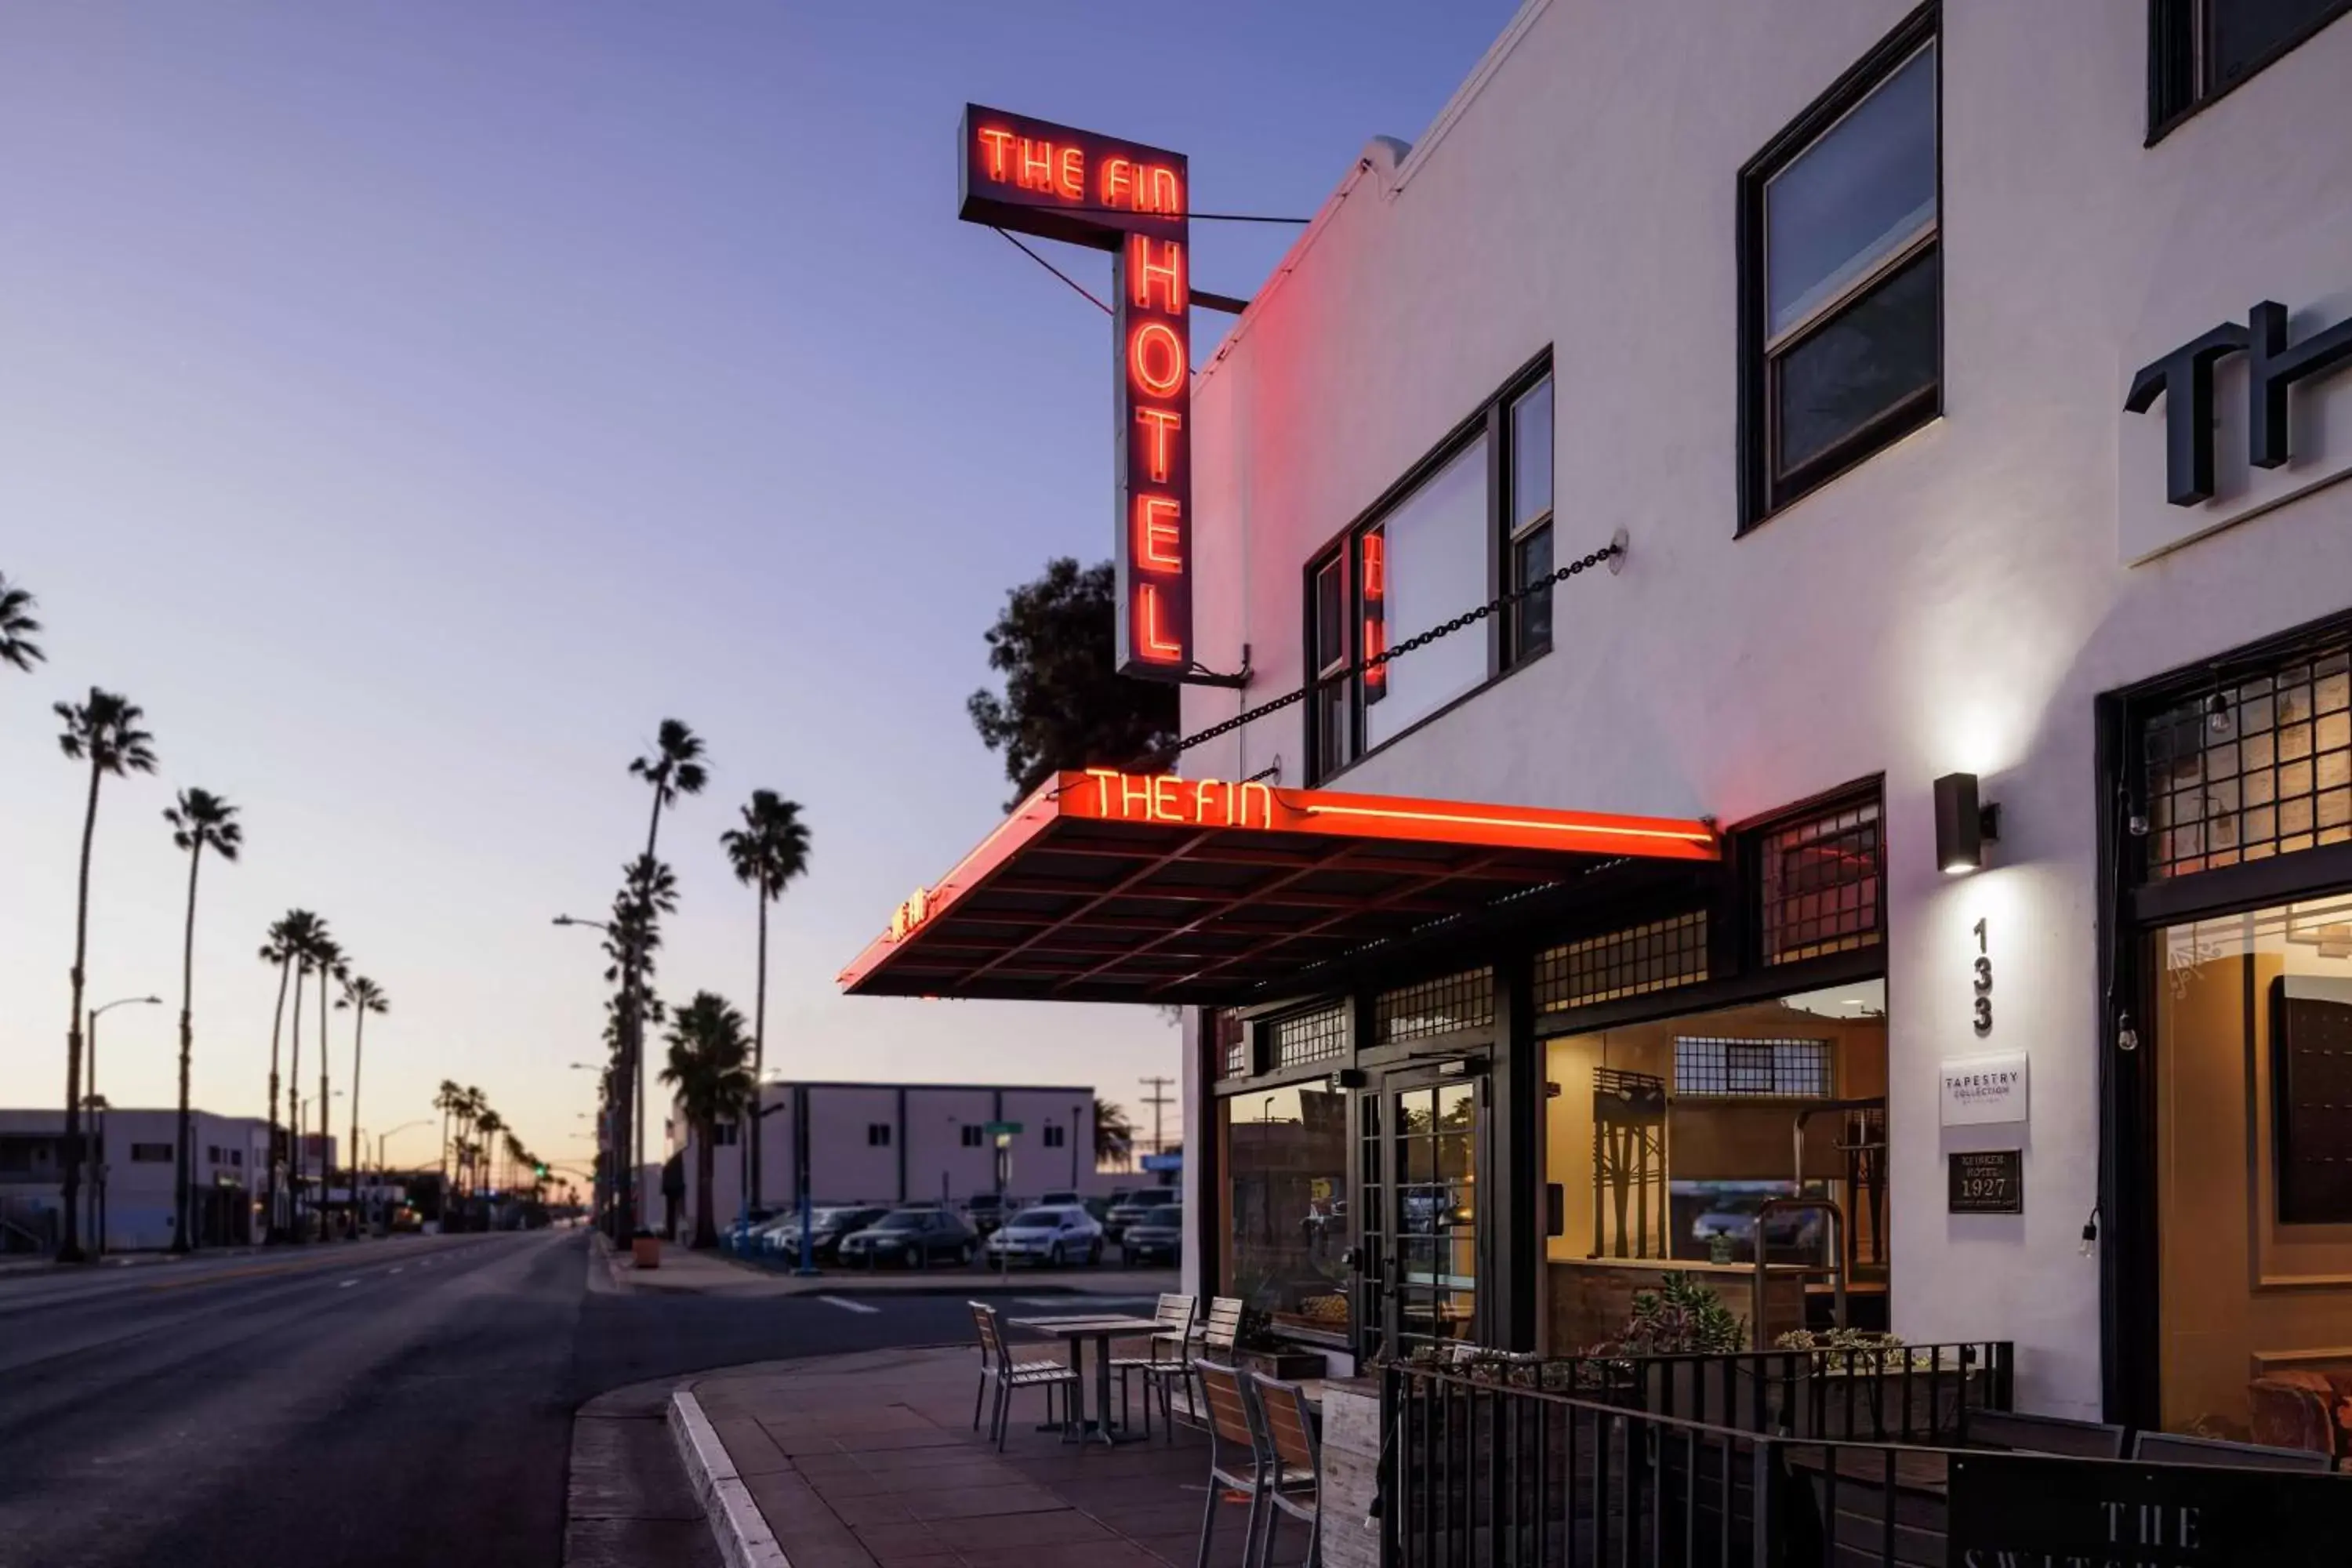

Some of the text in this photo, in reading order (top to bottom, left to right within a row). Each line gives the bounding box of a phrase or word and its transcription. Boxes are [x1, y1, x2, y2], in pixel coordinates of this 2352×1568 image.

[978, 128, 1083, 201] THE
[1131, 234, 1185, 661] HOTEL
[1086, 769, 1183, 822] THE
[1973, 917, 1992, 1032] 133
[1945, 1071, 2018, 1088] TAPESTRY
[1953, 1086, 2009, 1098] COLLECTION
[1962, 1178, 2005, 1198] 1927
[2100, 1502, 2200, 1548] THE
